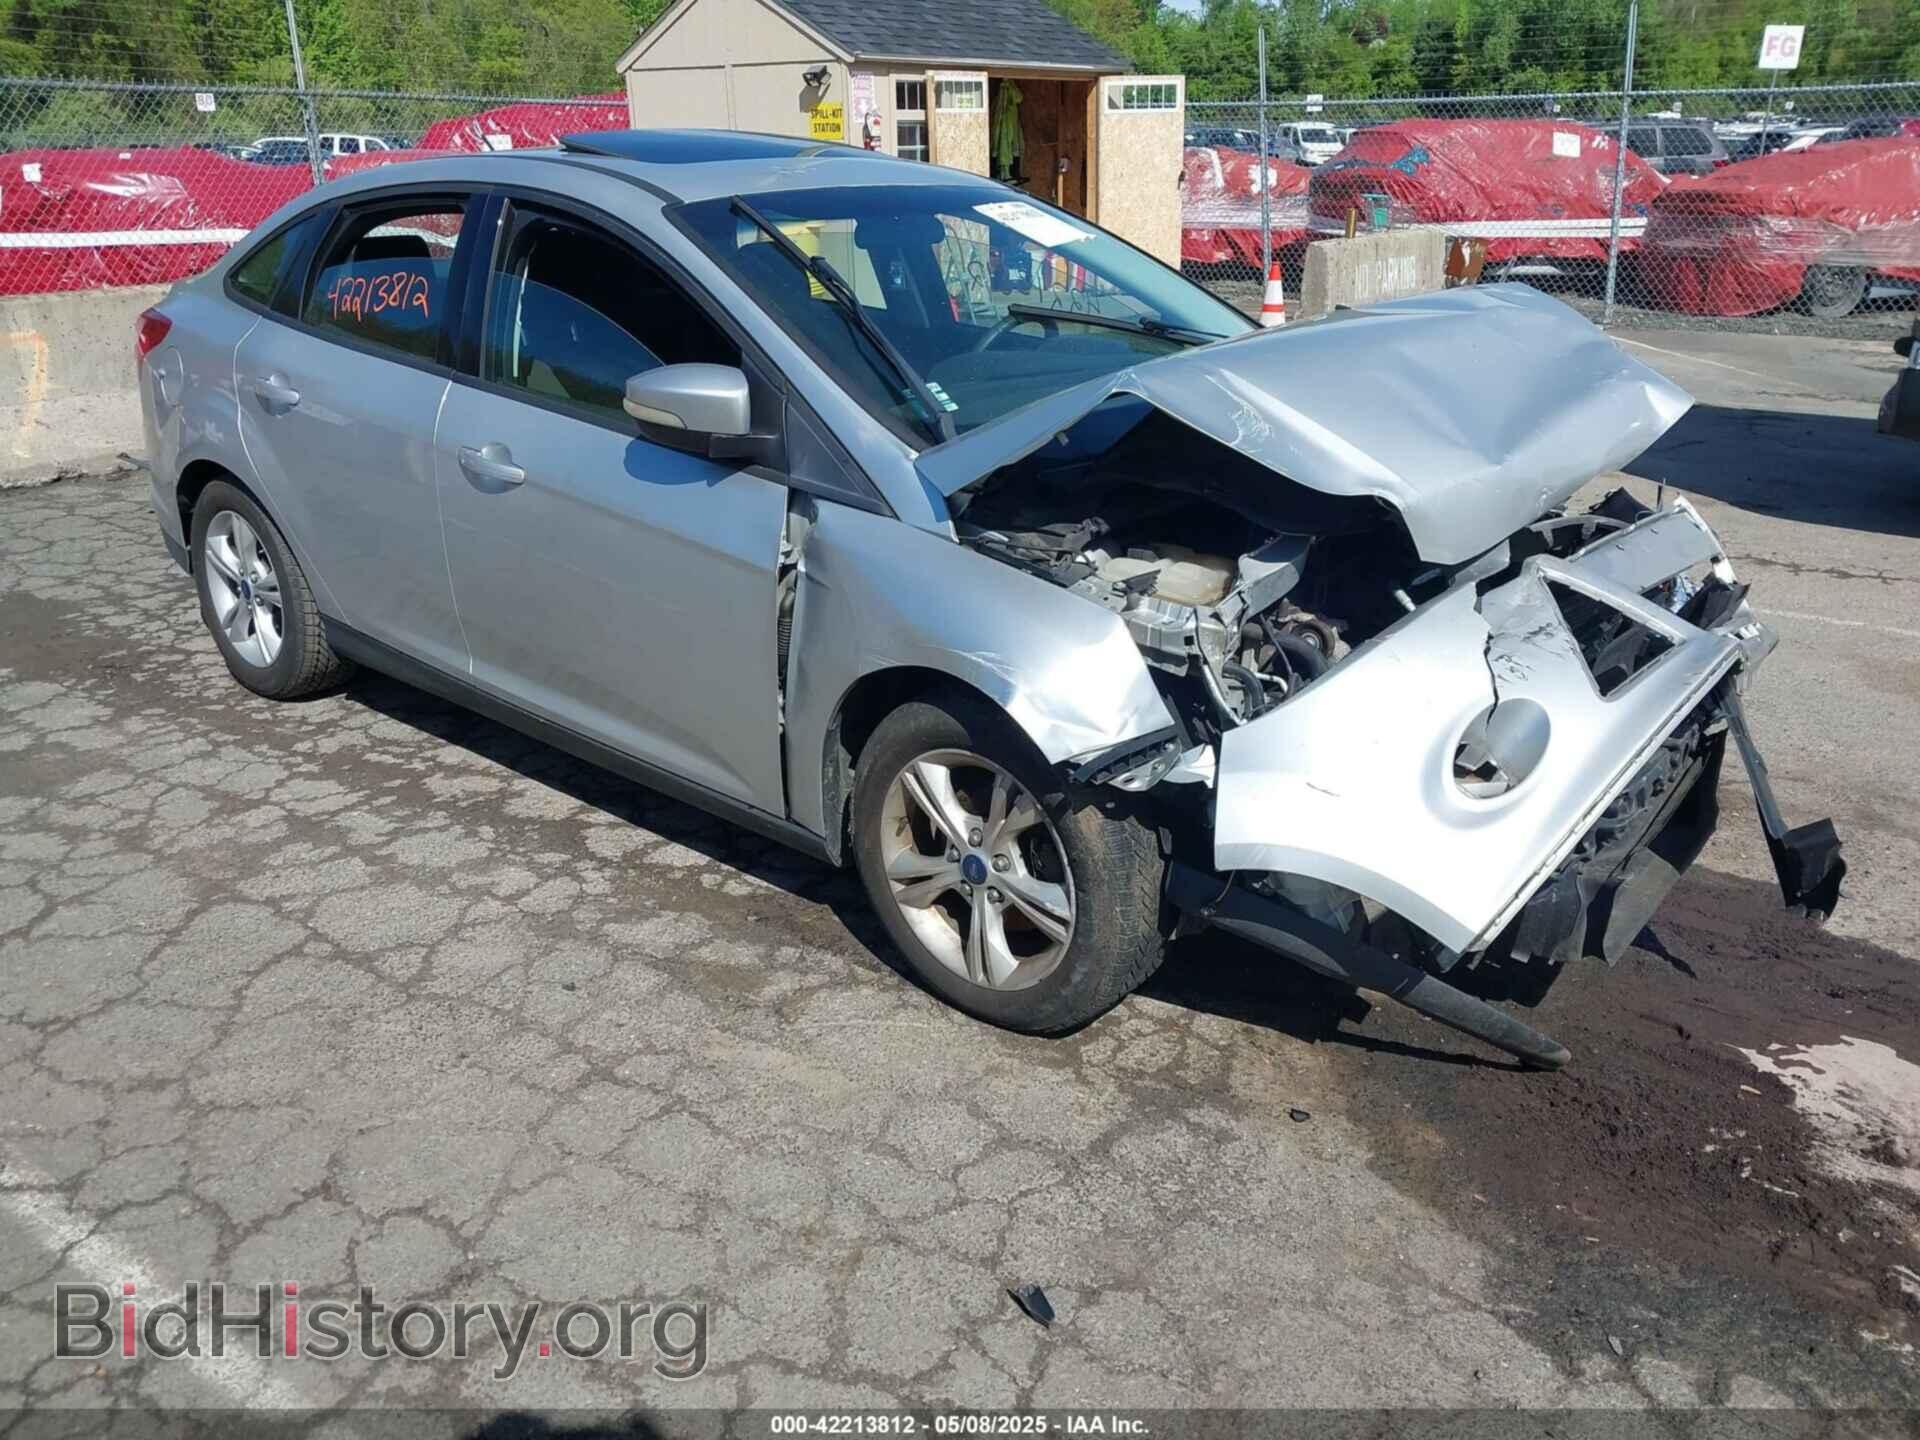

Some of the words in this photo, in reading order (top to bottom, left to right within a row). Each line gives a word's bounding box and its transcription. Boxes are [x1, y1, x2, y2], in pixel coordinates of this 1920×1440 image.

[1765, 35, 1797, 58] FG
[814, 122, 841, 133] STATION
[328, 271, 429, 322] 42213812
